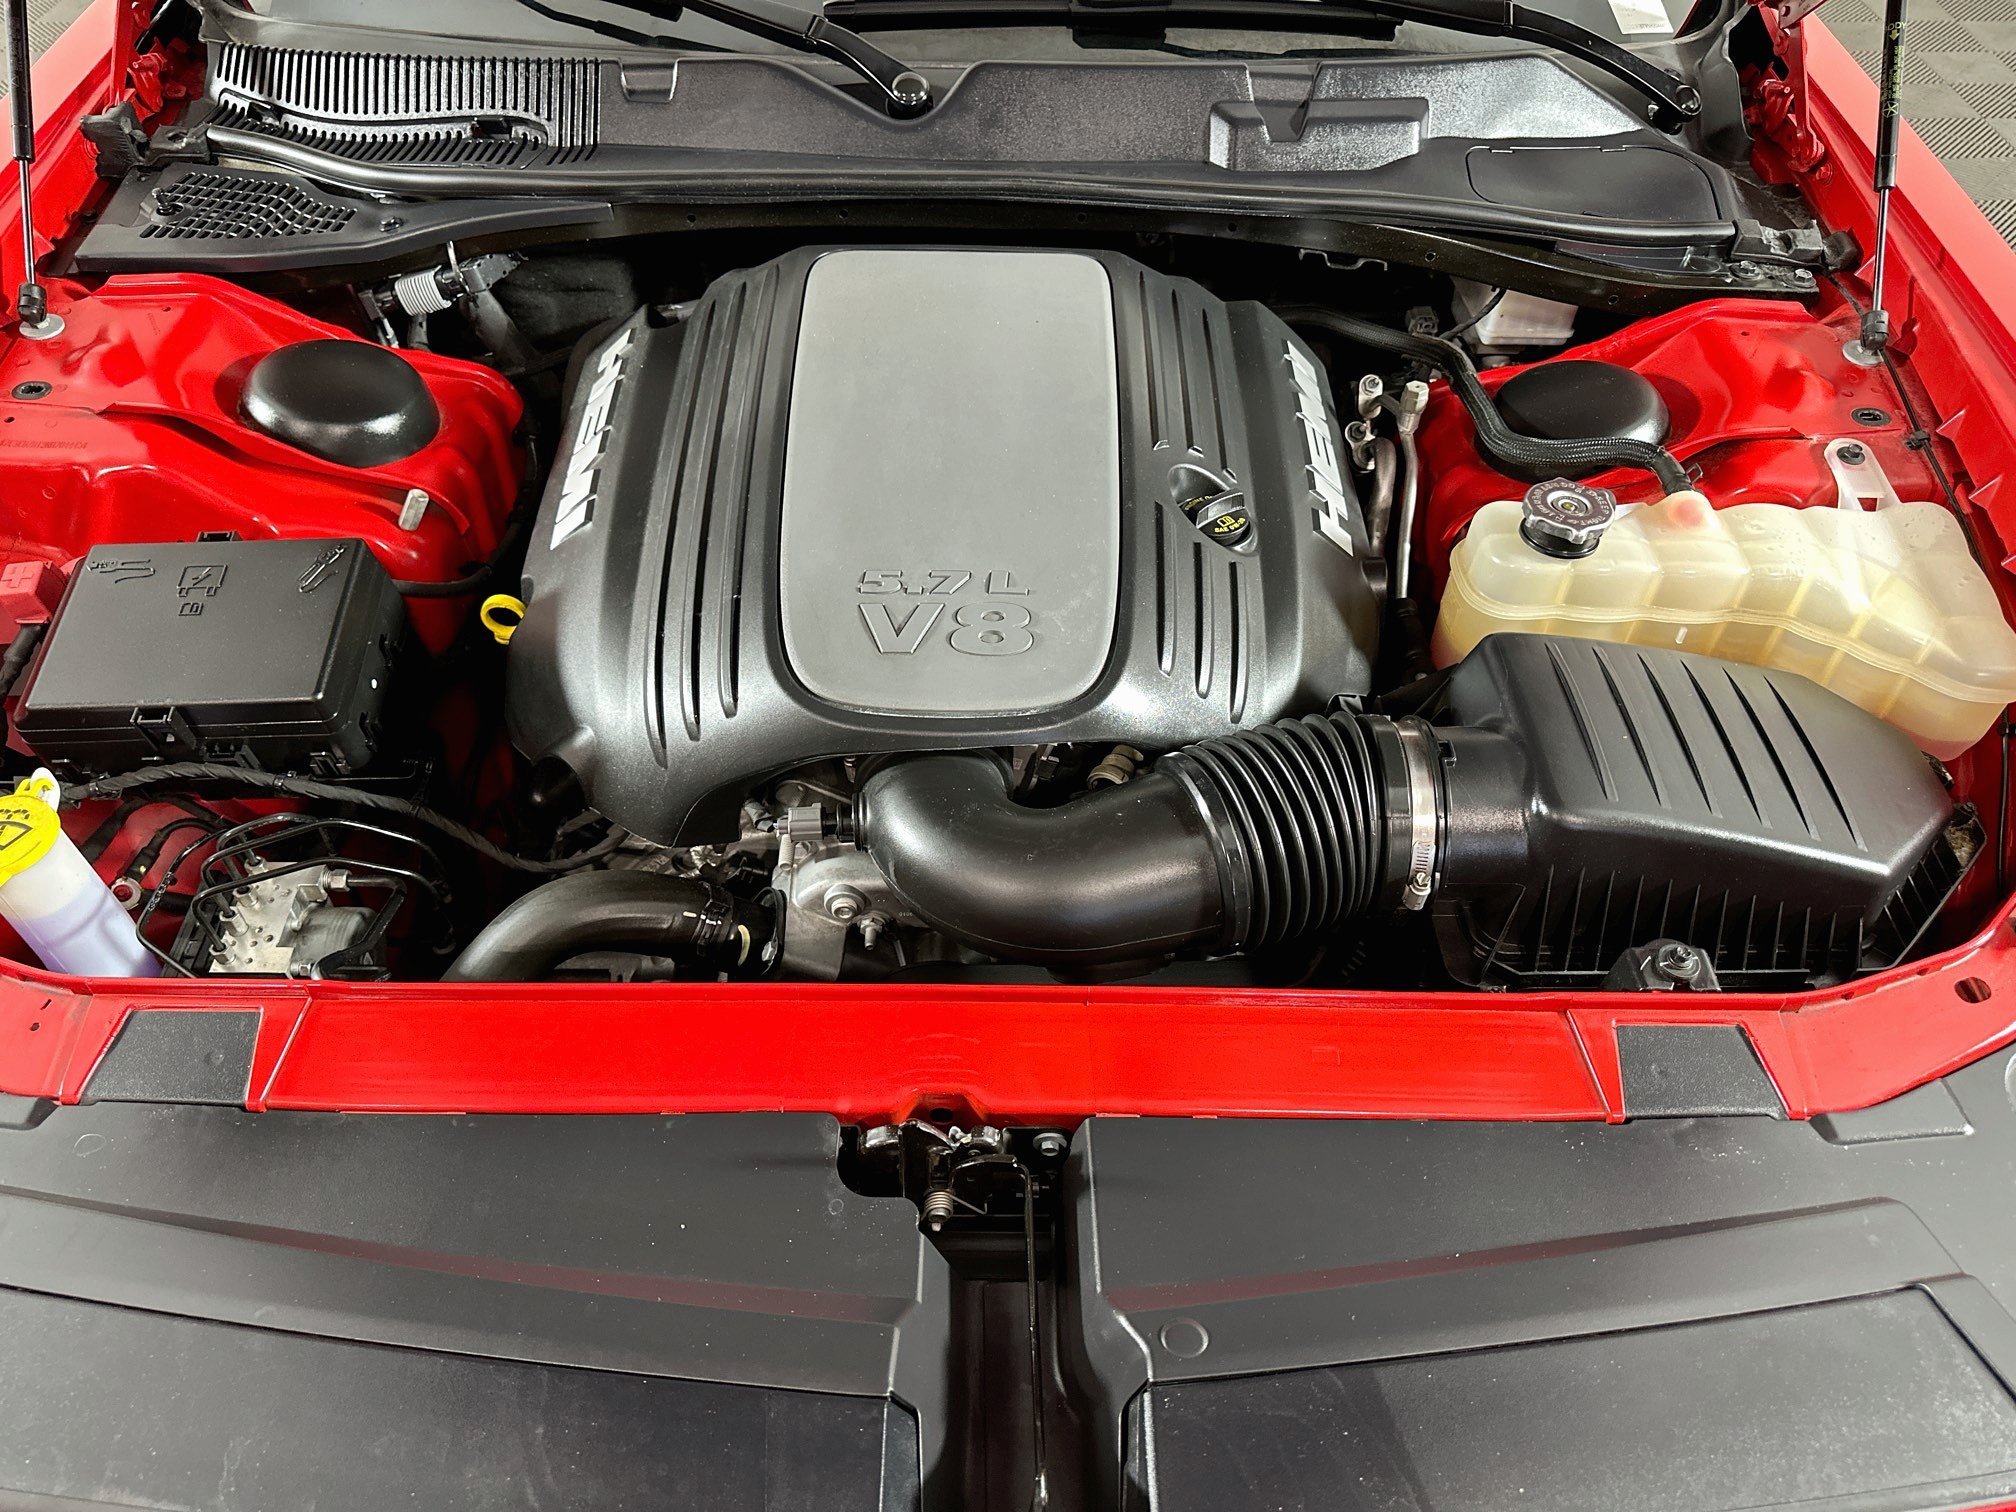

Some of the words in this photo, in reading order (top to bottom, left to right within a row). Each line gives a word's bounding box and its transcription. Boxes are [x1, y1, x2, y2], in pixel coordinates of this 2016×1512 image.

[550, 328, 636, 551] HEMI
[1284, 339, 1354, 558] HEMI
[856, 601, 1035, 657] V8
